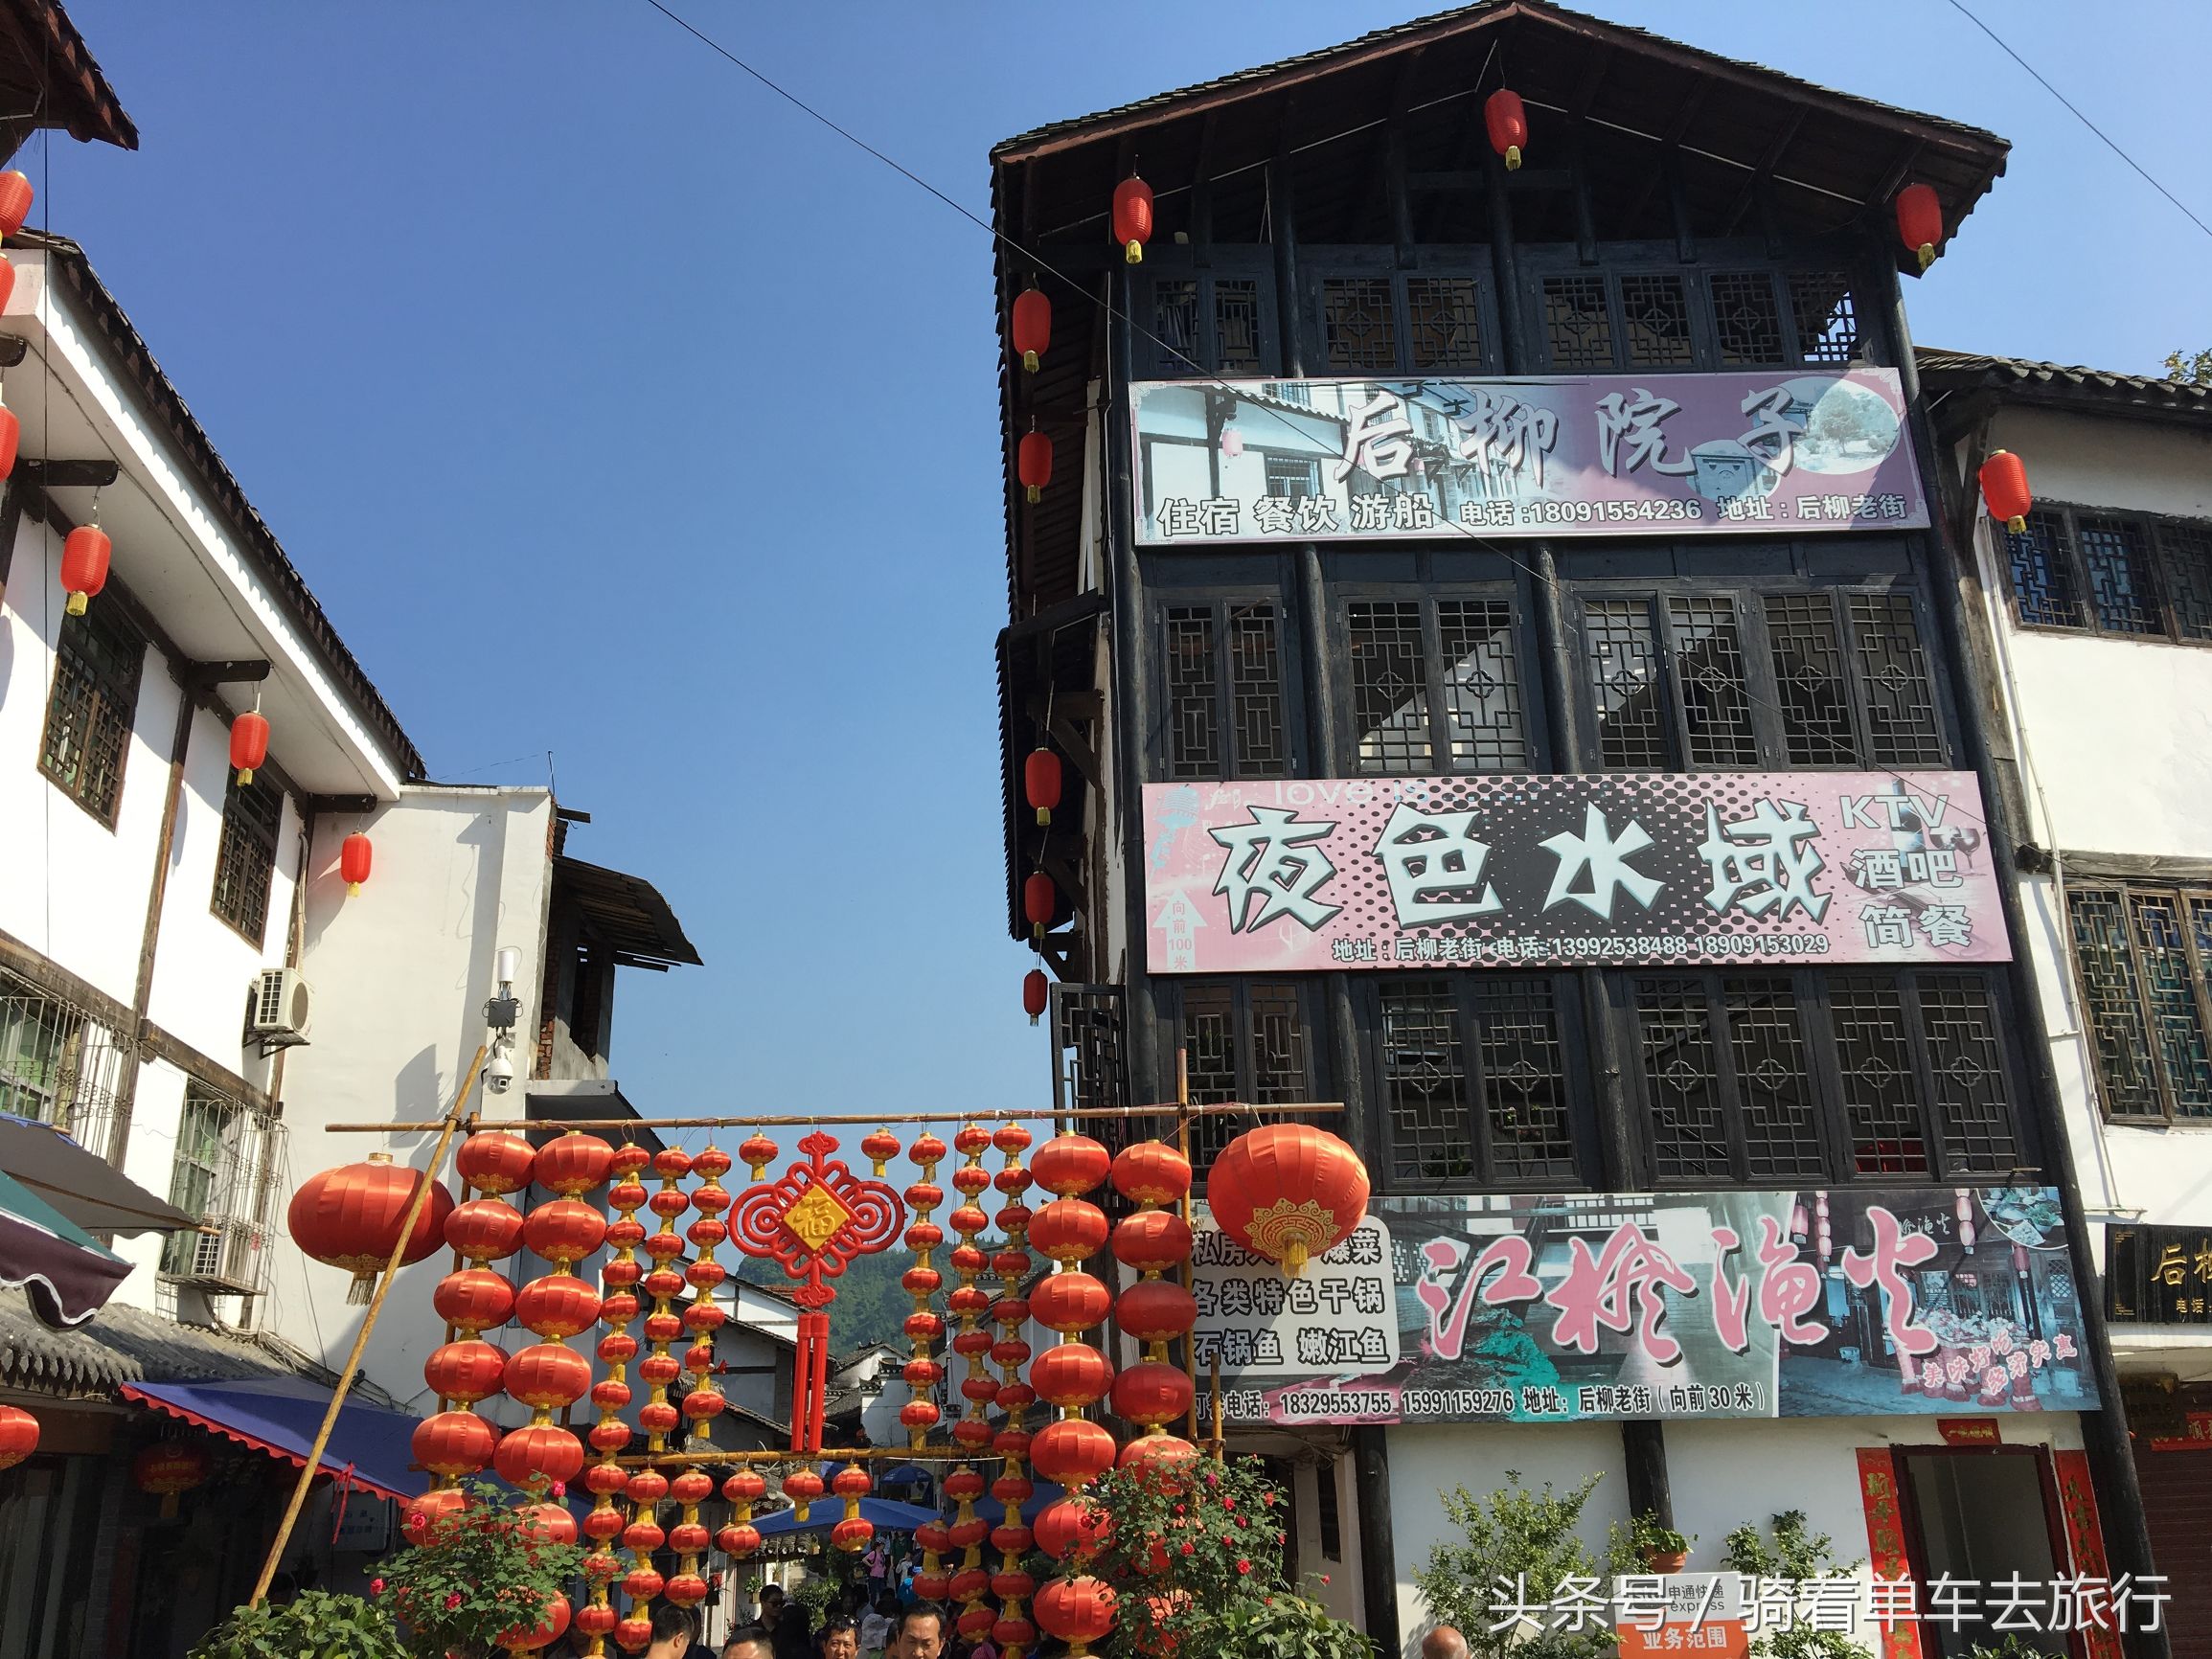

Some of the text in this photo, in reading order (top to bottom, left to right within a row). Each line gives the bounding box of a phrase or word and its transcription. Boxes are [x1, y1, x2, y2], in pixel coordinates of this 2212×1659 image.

[1334, 386, 1802, 489] 后柳院子
[1155, 496, 1241, 537] 住宿
[1253, 491, 1339, 534] 餐饮
[1349, 491, 1435, 531] 游船
[1274, 780, 1374, 806] love
[1838, 794, 1950, 829] KTV
[1208, 799, 1834, 936] 夜色水域
[1849, 848, 1964, 890] 酒吧
[1693, 934, 1832, 955] 18909153029
[1859, 904, 1973, 948] 简餐
[796, 1195, 836, 1239] 福
[1192, 1276, 1386, 1317] 各类特色干锅
[1194, 1327, 1391, 1367] 石锅鱼 嫩江鱼
[1400, 1389, 1515, 1415] 15991159276
[1642, 1625, 1728, 1650] 业务范围
